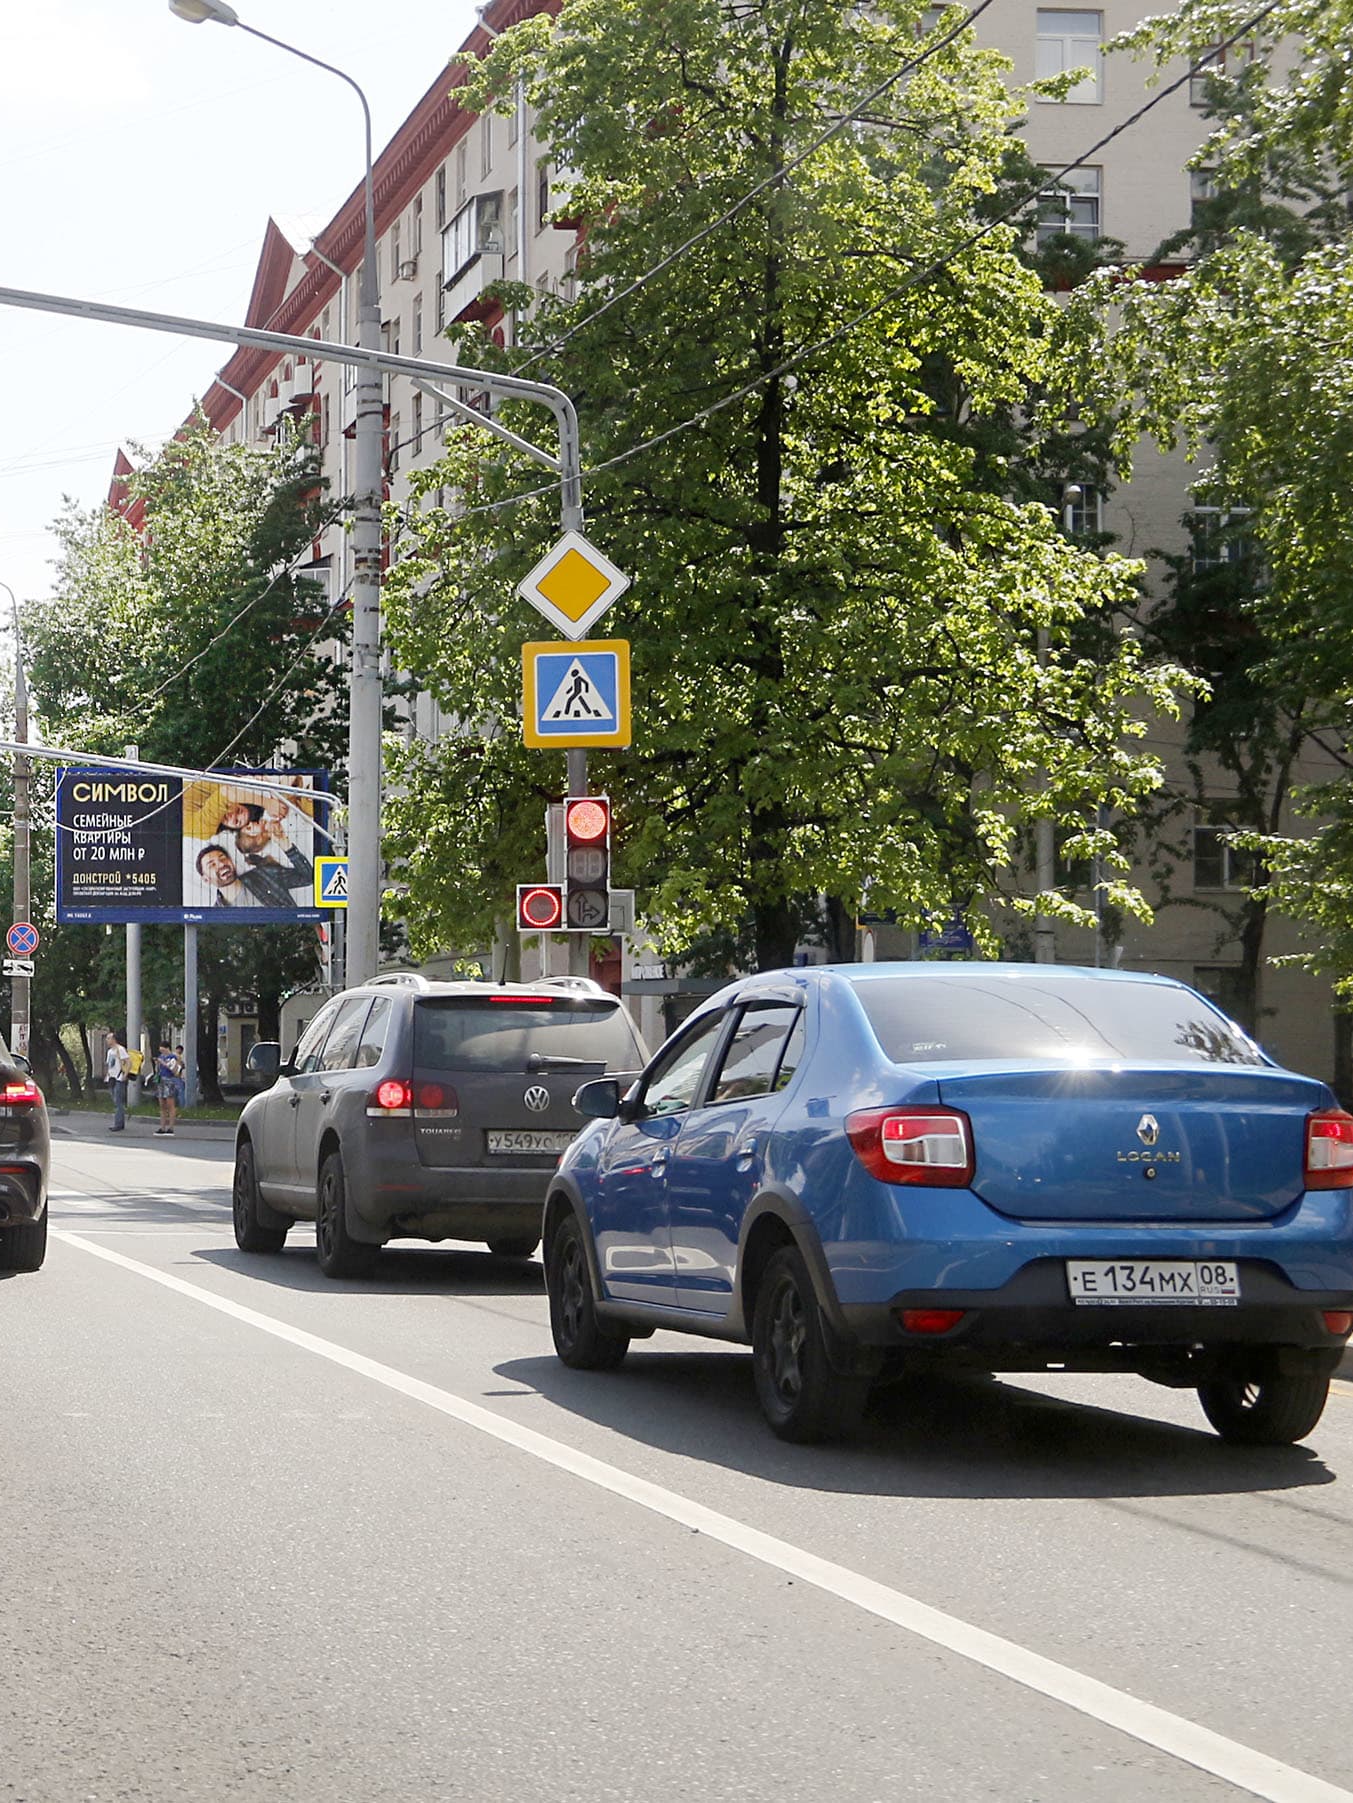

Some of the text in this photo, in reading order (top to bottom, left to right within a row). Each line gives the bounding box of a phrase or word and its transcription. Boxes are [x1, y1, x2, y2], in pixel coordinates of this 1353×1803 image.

[73, 783, 168, 803] СИМВОЛ
[73, 812, 133, 828] СЕМЕЙНЫЕ
[73, 831, 131, 844] КВАРТИРЫ
[73, 847, 87, 861] ОТ
[90, 846, 106, 861] 20
[109, 847, 135, 861] МЛН
[72, 871, 121, 884] ДОНСТРОЙ
[1200, 1265, 1227, 1285] 08
